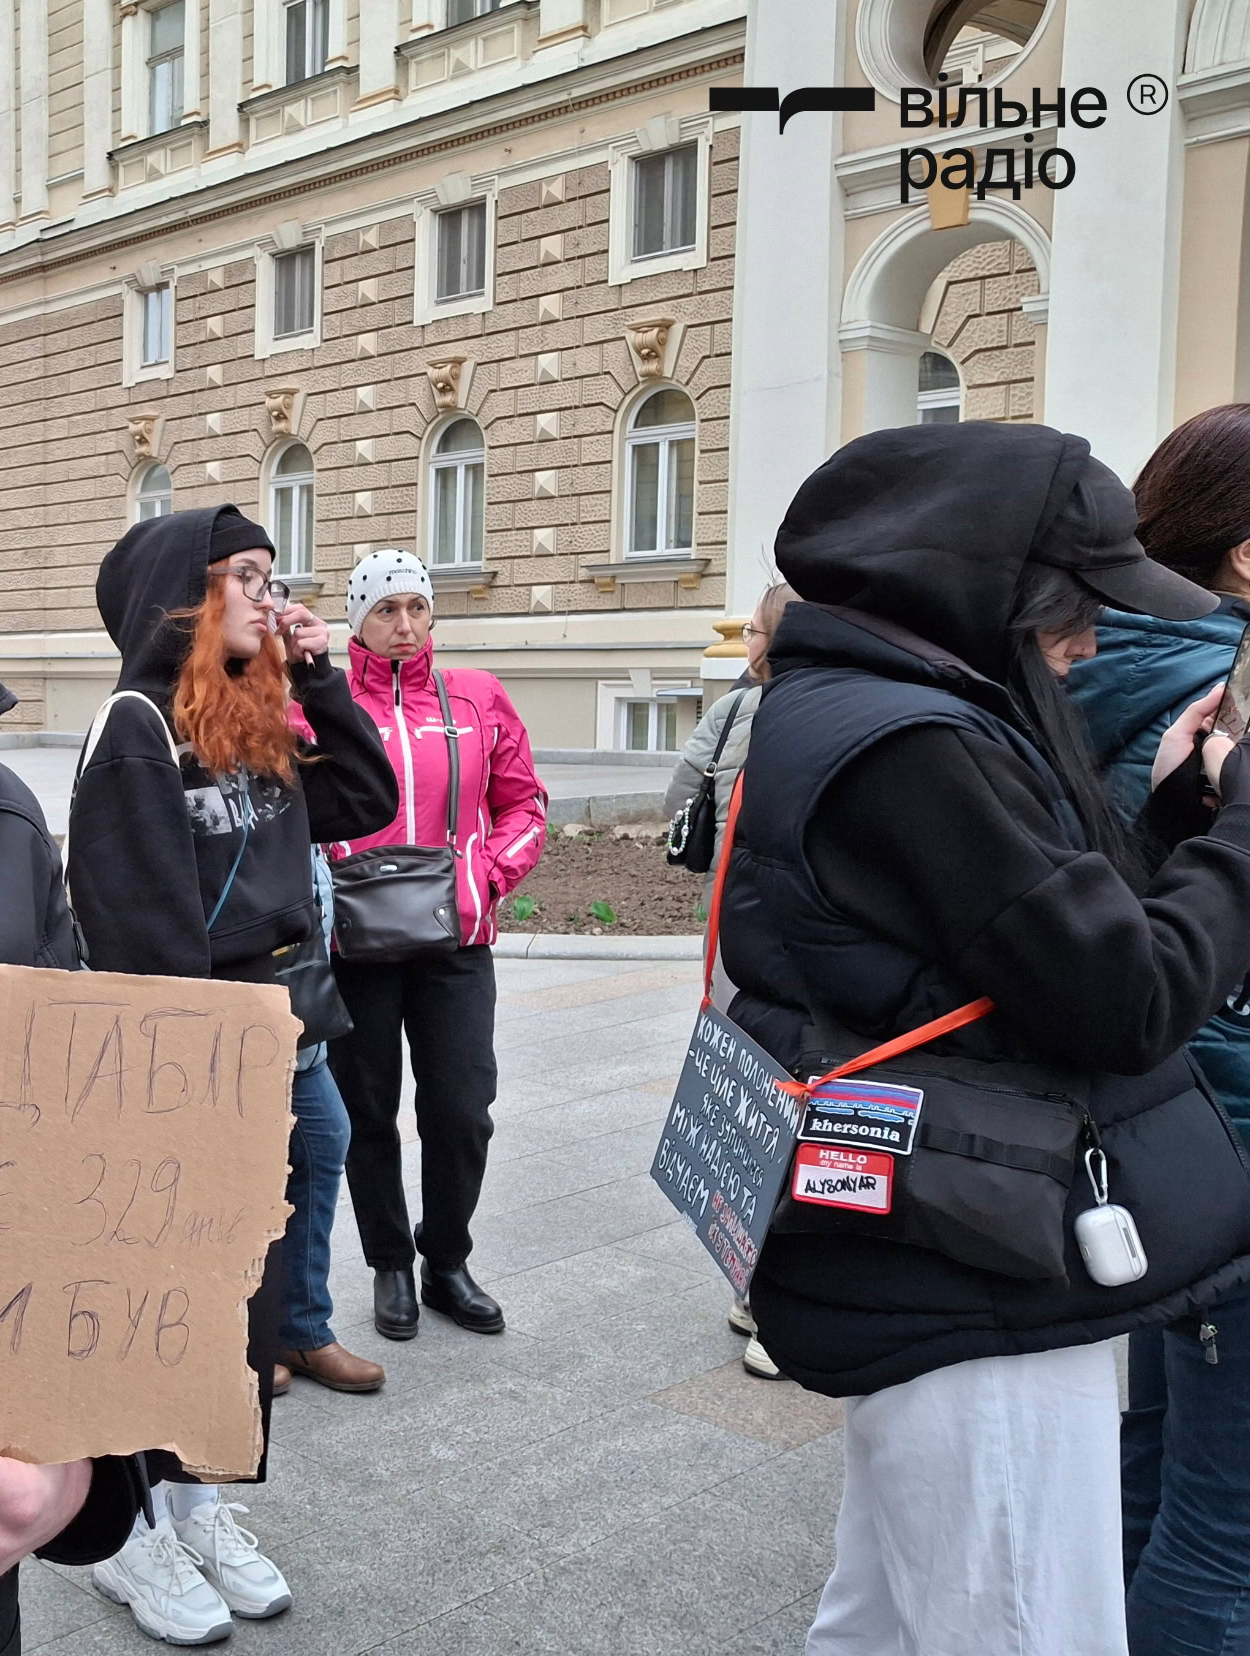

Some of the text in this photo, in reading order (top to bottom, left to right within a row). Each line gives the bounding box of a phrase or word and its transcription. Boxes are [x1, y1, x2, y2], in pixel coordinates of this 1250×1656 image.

[697, 1015, 737, 1063] КОЖЕН
[710, 1062, 737, 1108] ЦІЛЕ
[700, 1092, 721, 1126] ЯКЕ
[810, 1118, 900, 1142] khersonia
[659, 1138, 710, 1218] ВІДЧАЄМ
[671, 1101, 757, 1225] МІЖ НАДІЄЮ ТА
[819, 1150, 867, 1164] HELLO
[820, 1160, 832, 1168] my
[834, 1161, 853, 1169] name
[70, 1153, 181, 1249] 329
[62, 1279, 192, 1368] БУВ
